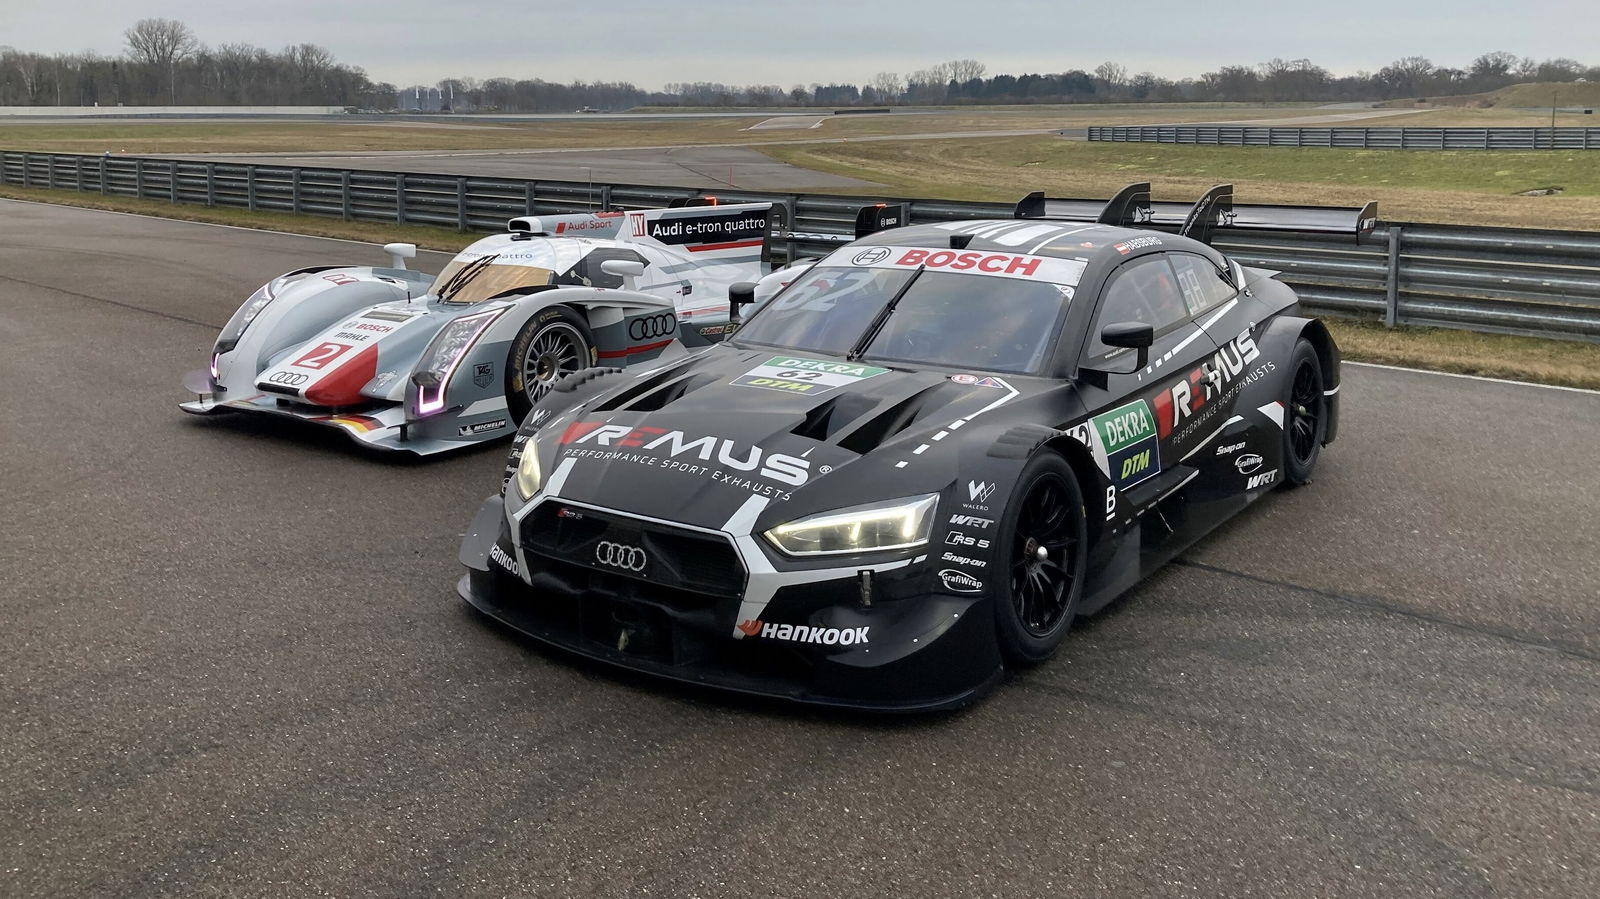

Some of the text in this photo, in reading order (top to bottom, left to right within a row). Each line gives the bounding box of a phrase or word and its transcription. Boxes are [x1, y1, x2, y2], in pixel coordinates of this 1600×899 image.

[568, 220, 612, 231] Audi Sport
[631, 214, 645, 236] HY
[652, 218, 766, 237] Audi e-tron quattro
[895, 249, 1043, 276] BOSCH
[334, 331, 371, 342] MAHLE
[356, 323, 394, 334] BOSCH
[298, 343, 342, 368] 2
[776, 370, 823, 381] 62
[778, 359, 866, 377] DEKRA
[747, 378, 815, 392] DTM
[1171, 327, 1261, 428] REMUS
[474, 420, 506, 431] MICHELIN
[1105, 407, 1150, 448] DEKRA
[576, 423, 811, 487] REMUS
[1215, 441, 1246, 456] Snap-on
[1121, 449, 1150, 480] DTM
[563, 448, 793, 501] PERFORMANCE SPORT EXHAUSTS
[1246, 468, 1278, 491] WRT
[962, 503, 989, 511] WALERO
[1106, 484, 1117, 514] B
[949, 514, 995, 529] WRT
[950, 532, 991, 549] RS 5
[941, 551, 987, 568] Snap-on
[941, 572, 983, 589] GrafiWrap
